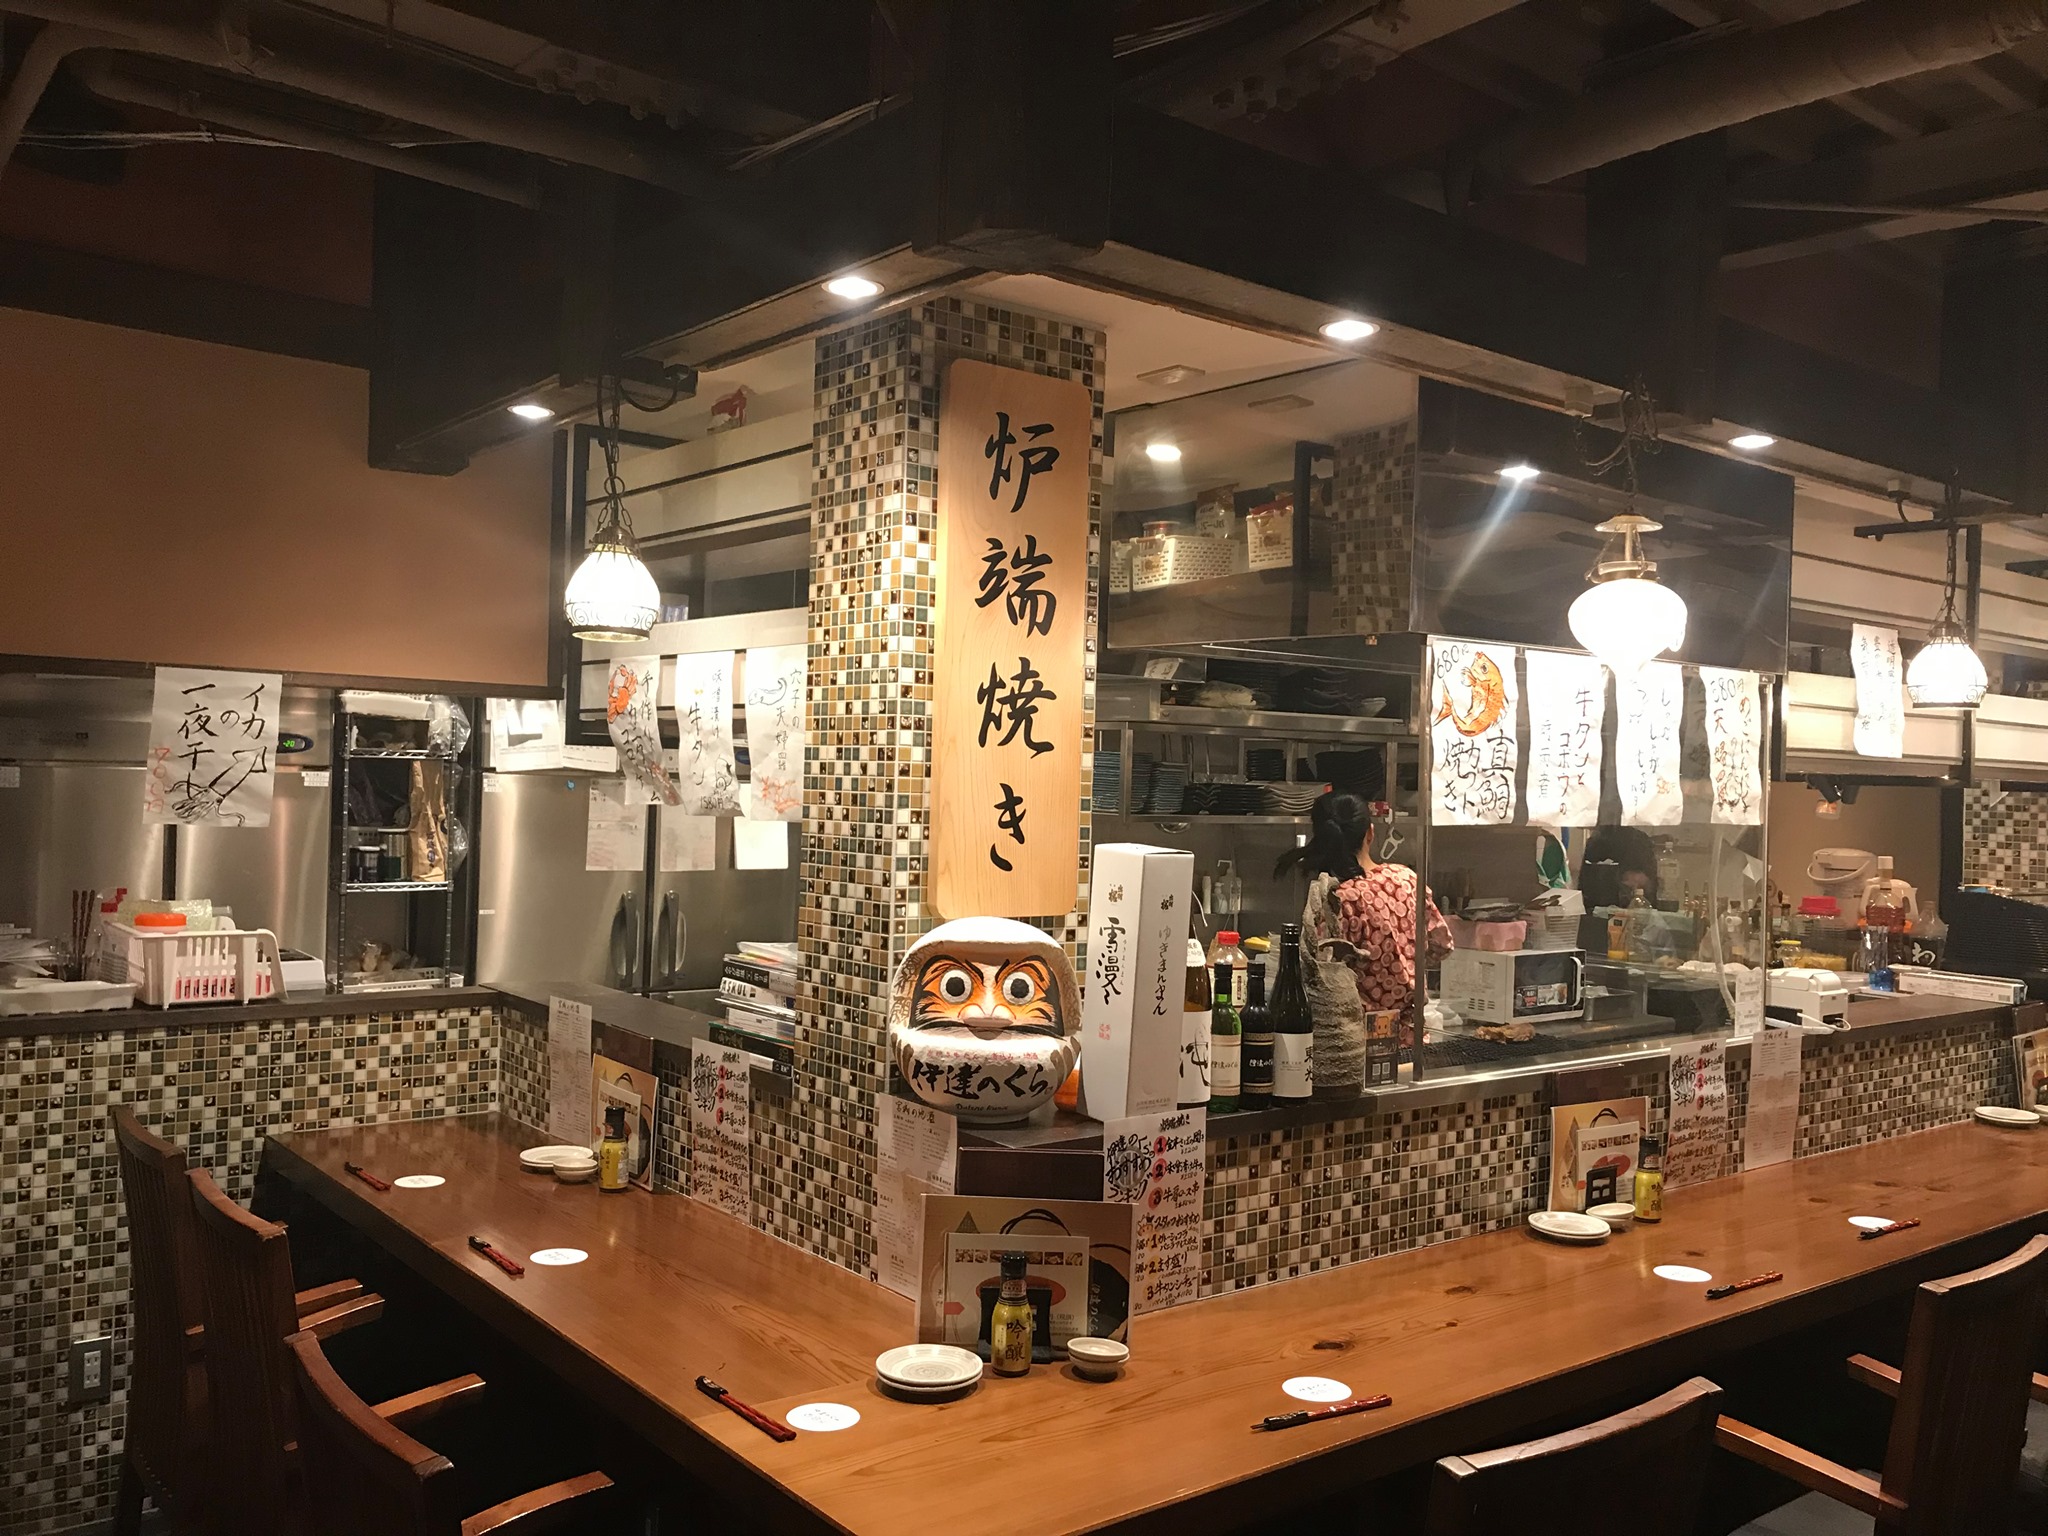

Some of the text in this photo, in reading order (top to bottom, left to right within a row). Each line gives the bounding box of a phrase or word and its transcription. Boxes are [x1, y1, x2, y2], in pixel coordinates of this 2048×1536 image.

[974, 411, 1060, 872] 炉端焼き
[220, 710, 240, 728] の
[242, 683, 265, 739] イカ
[790, 669, 802, 729] 穴子の
[687, 701, 705, 786] 牛タン
[1575, 687, 1594, 786] 牛タンと
[1482, 729, 1514, 820] 真鯛
[721, 979, 747, 997] ASKUL
[911, 1058, 1050, 1100] 伊達のくら
[1105, 1152, 1152, 1185] おすすめ
[1157, 1137, 1164, 1152] 1
[1156, 1163, 1163, 1177] 2
